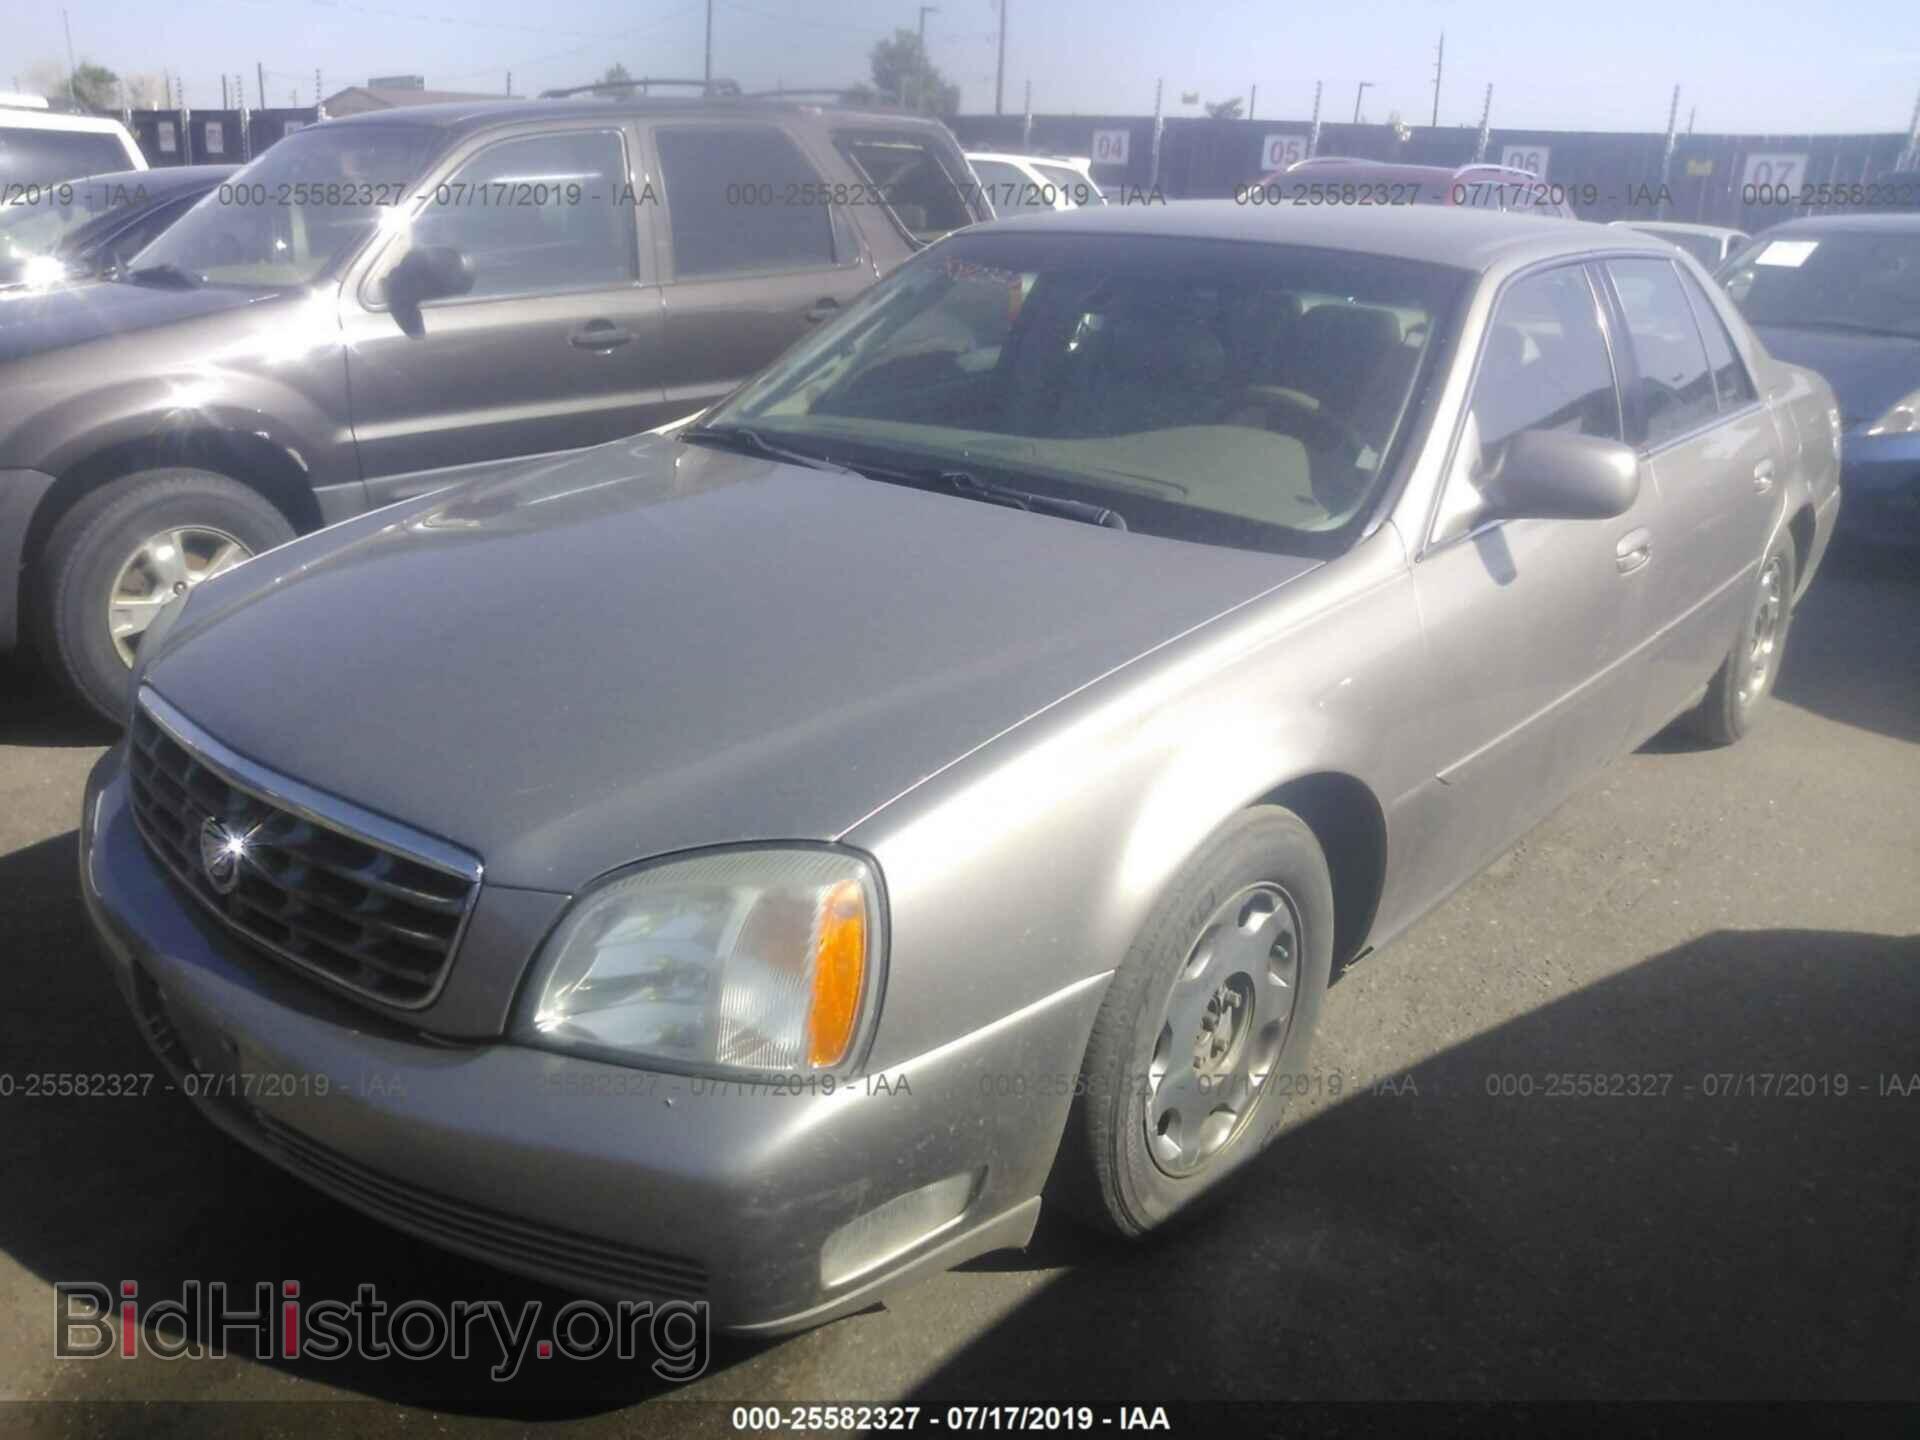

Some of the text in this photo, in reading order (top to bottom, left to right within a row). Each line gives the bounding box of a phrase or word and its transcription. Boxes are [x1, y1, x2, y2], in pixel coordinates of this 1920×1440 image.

[1101, 135, 1122, 160] 04
[1270, 141, 1299, 165] 05
[1754, 160, 1796, 187] 07
